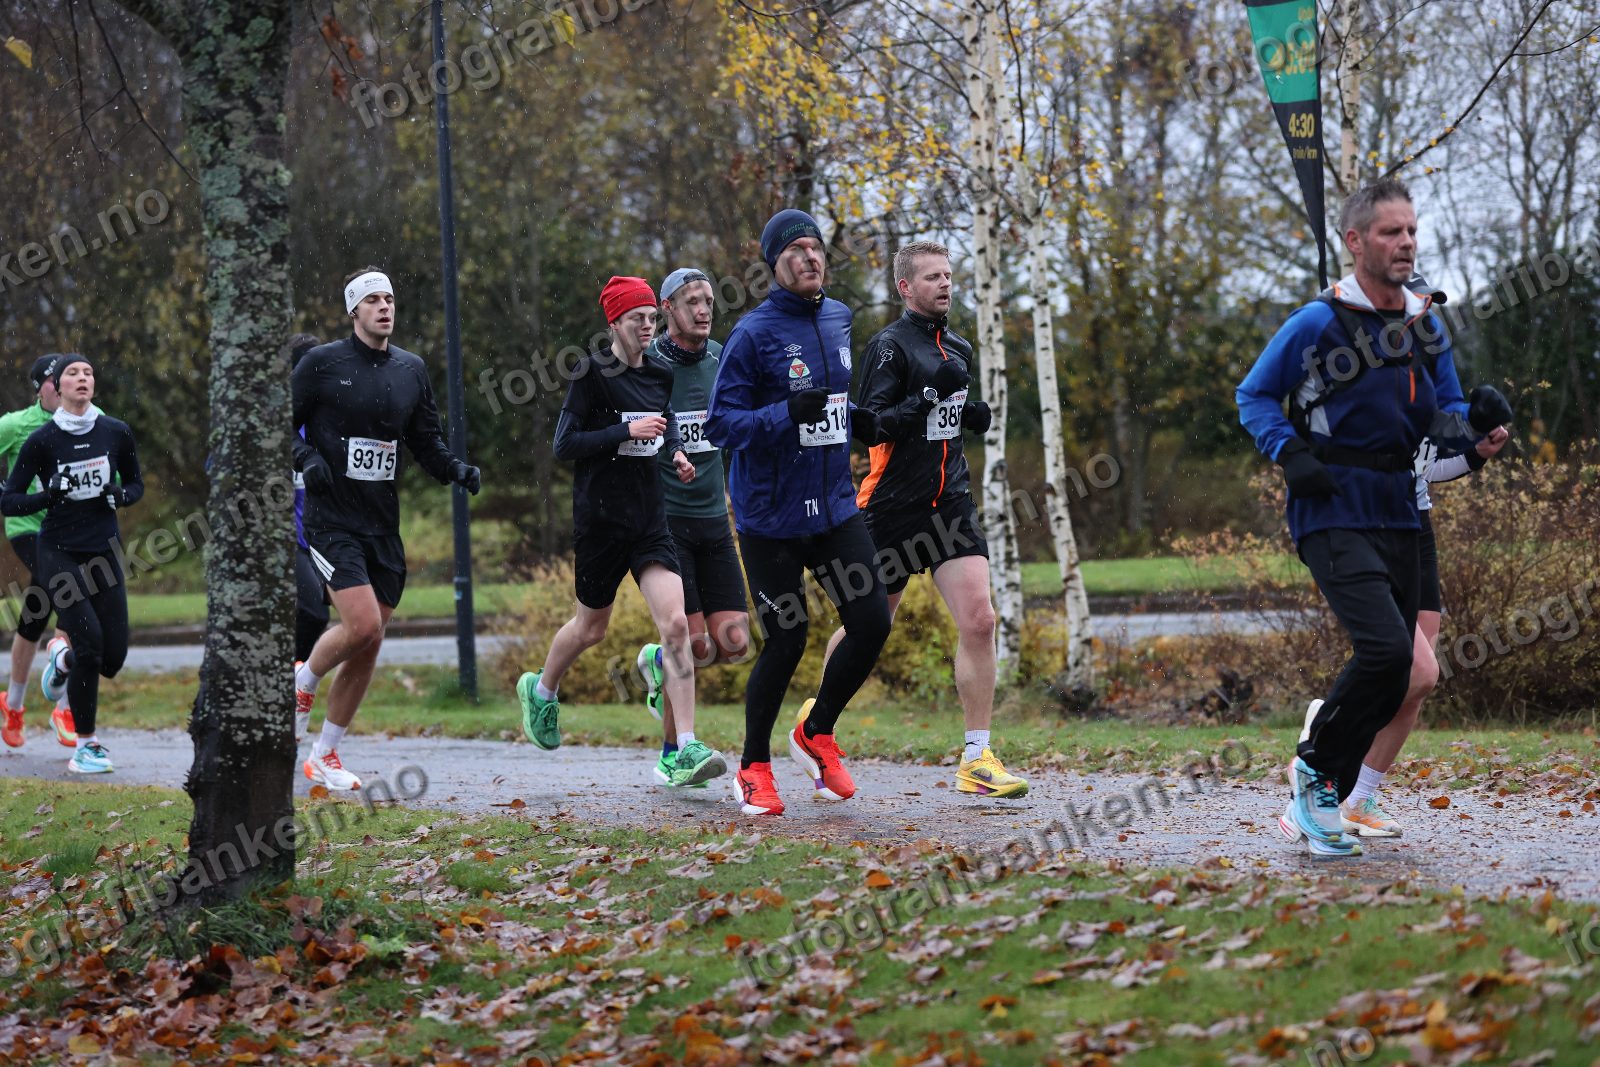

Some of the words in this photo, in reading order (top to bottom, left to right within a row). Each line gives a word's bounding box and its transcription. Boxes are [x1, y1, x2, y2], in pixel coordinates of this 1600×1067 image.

[1288, 113, 1315, 138] 4:30
[353, 448, 396, 471] 9315
[804, 498, 819, 517] TN
